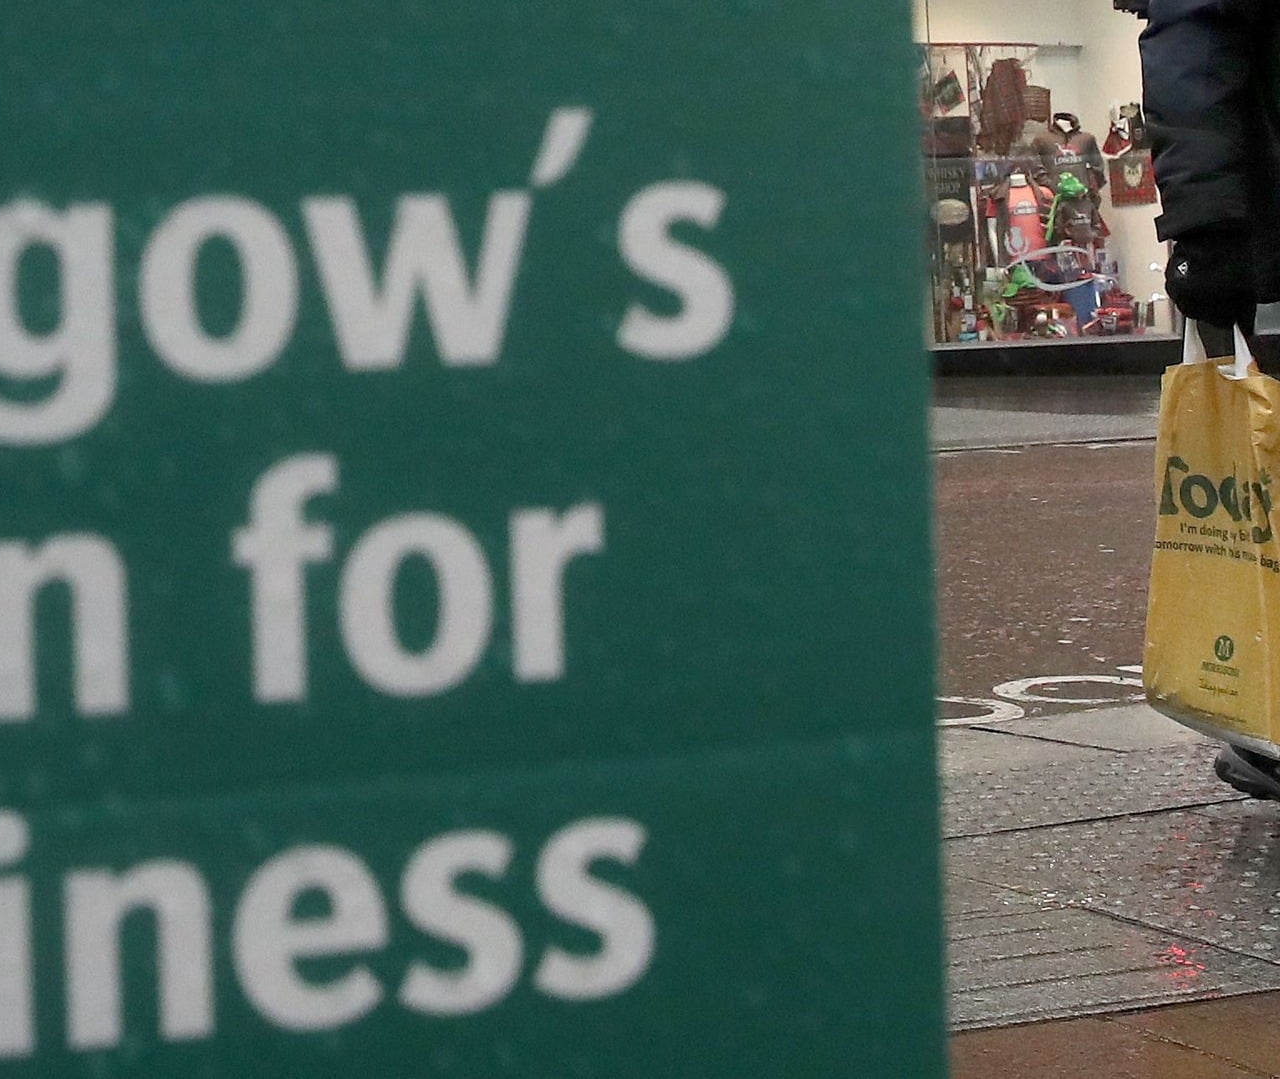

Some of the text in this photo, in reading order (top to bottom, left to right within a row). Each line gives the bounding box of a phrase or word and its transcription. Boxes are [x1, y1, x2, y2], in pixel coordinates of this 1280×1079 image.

[1180, 522, 1197, 534] I'm
[1200, 524, 1228, 542] doing
[1205, 544, 1226, 557] with
[1260, 554, 1280, 574] bag
[231, 452, 604, 702] for
